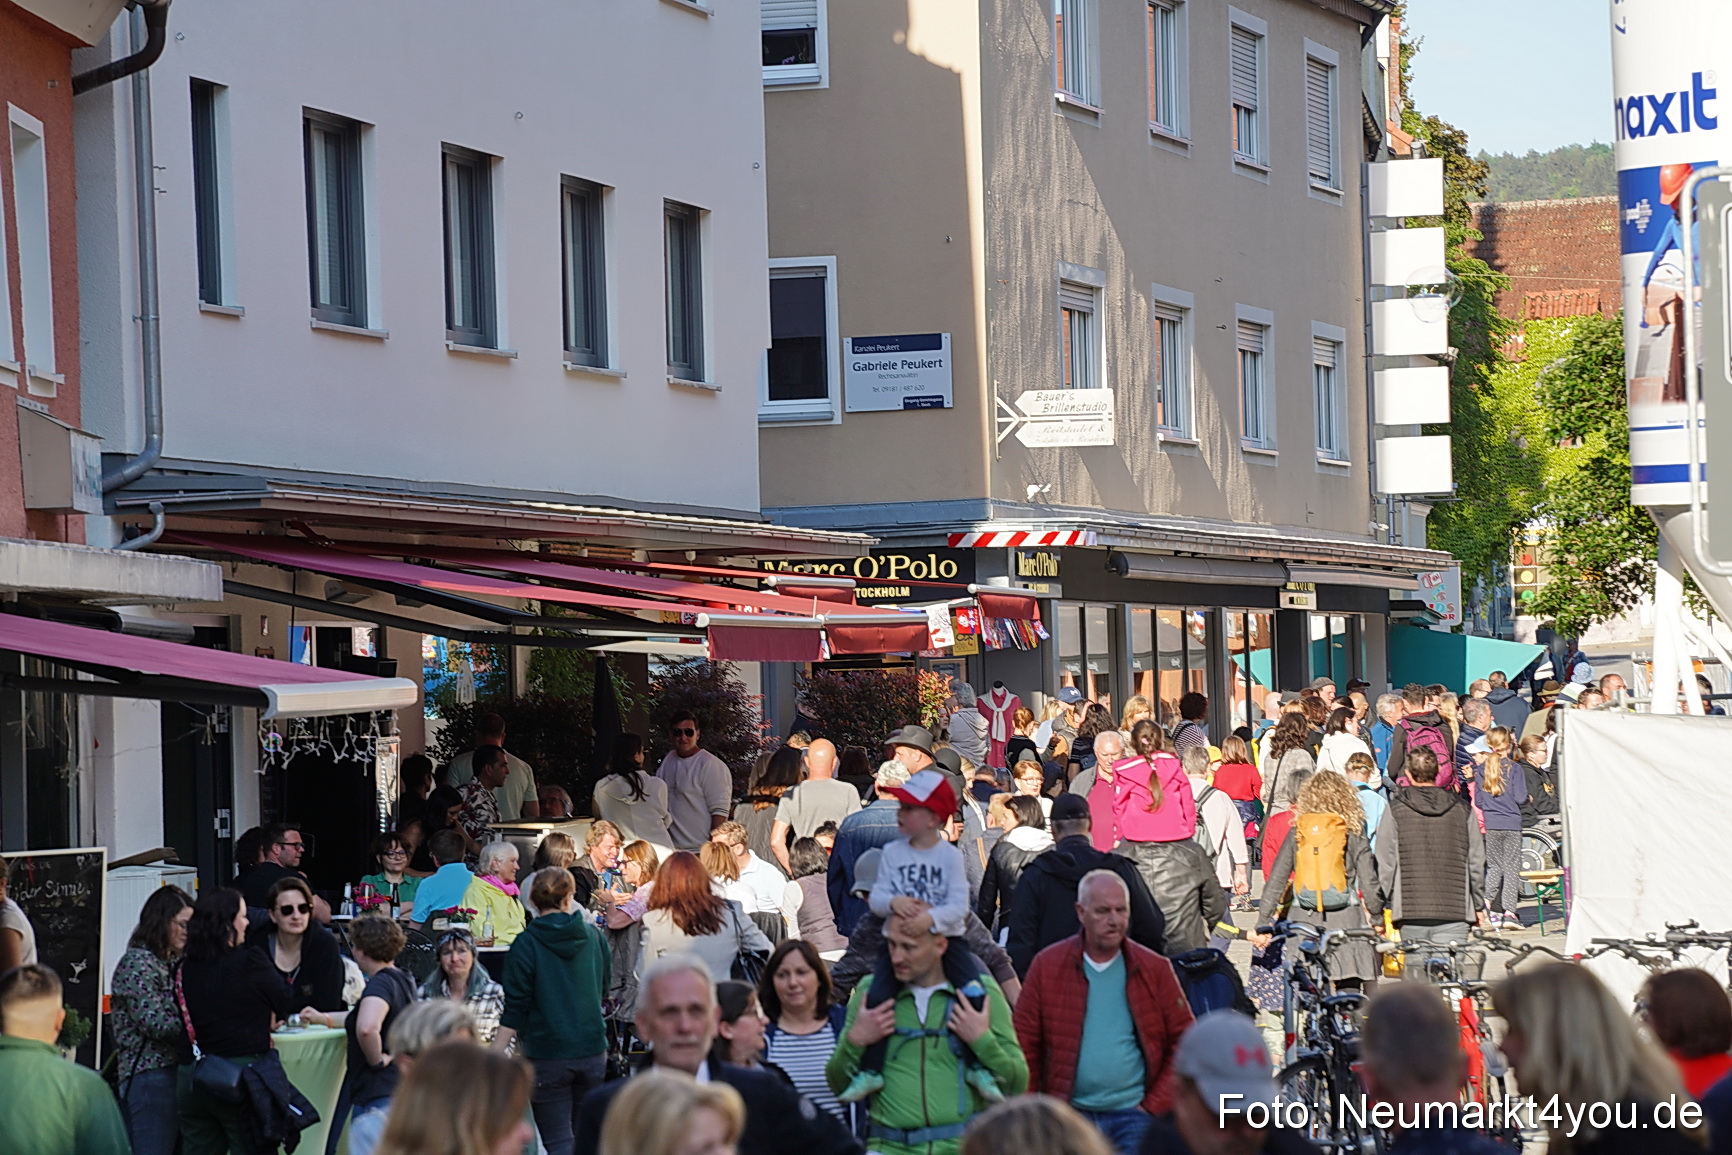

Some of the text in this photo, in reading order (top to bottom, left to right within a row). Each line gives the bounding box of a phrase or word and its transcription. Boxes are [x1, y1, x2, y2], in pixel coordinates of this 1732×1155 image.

[854, 344, 900, 353] Kanzlei Peukert
[852, 358, 943, 372] Gabriele Peukert
[1034, 391, 1075, 402] Bauer's
[1041, 402, 1108, 413] Brillenstudio
[853, 553, 958, 580] O'Polo
[1018, 552, 1037, 577] Marc
[853, 586, 911, 599] TOCKHOLM
[898, 864, 942, 886] TEAM
